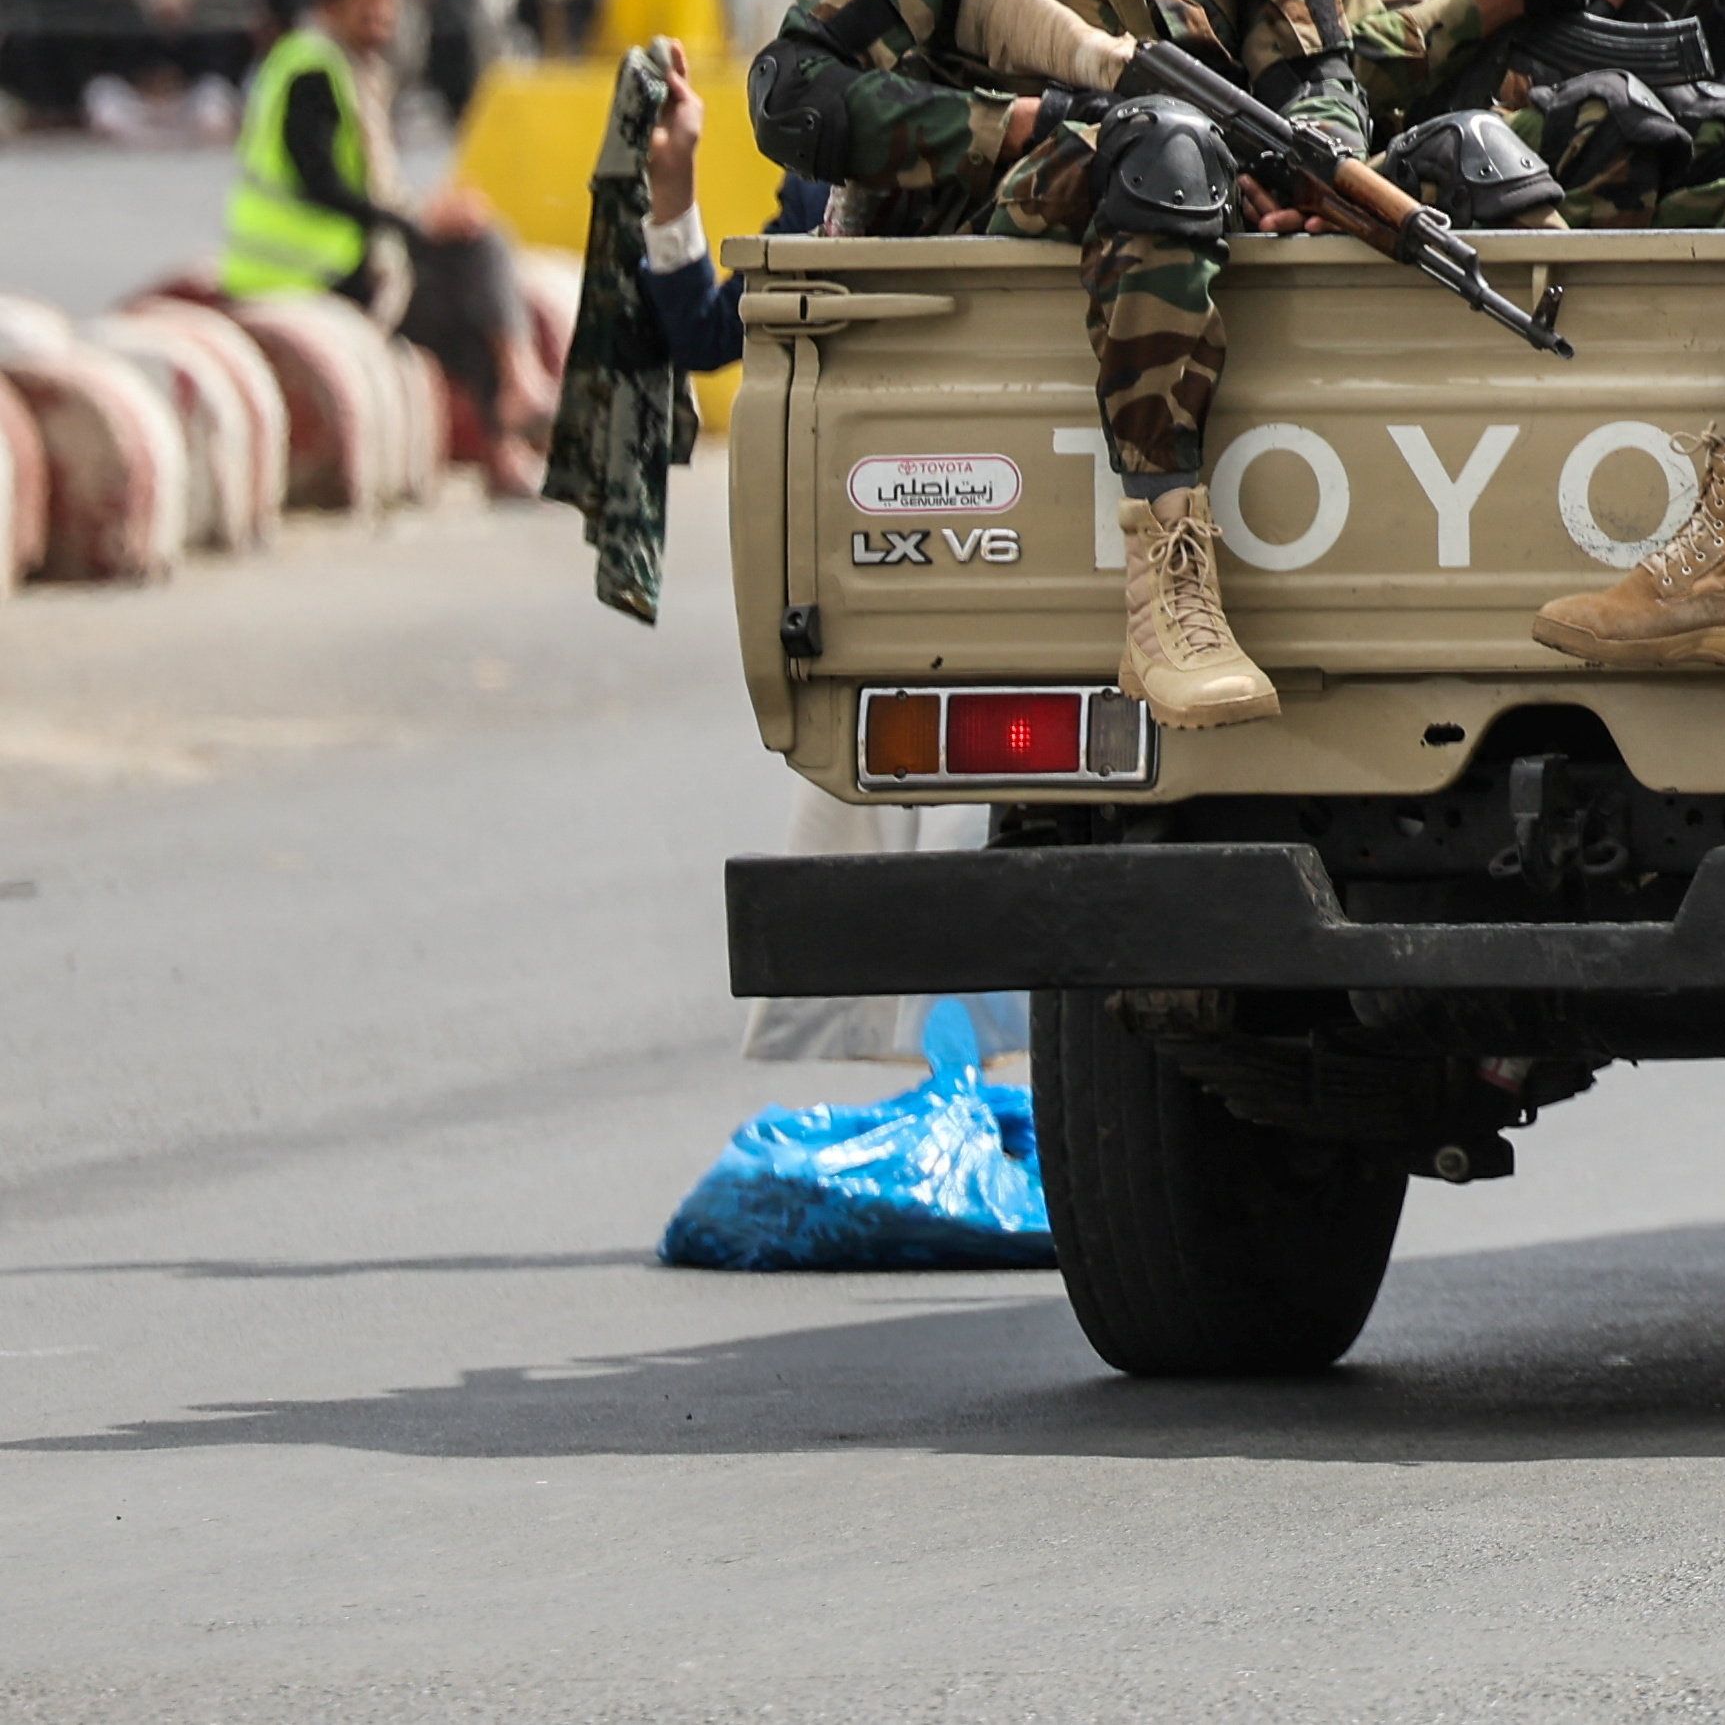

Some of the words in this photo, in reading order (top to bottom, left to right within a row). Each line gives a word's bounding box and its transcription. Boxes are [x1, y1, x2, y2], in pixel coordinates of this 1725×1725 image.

[919, 461, 973, 474] TOYOTA
[955, 480, 993, 503] زيت
[900, 496, 957, 507] GENUINE
[852, 530, 933, 565] LX
[941, 528, 1021, 563] V6
